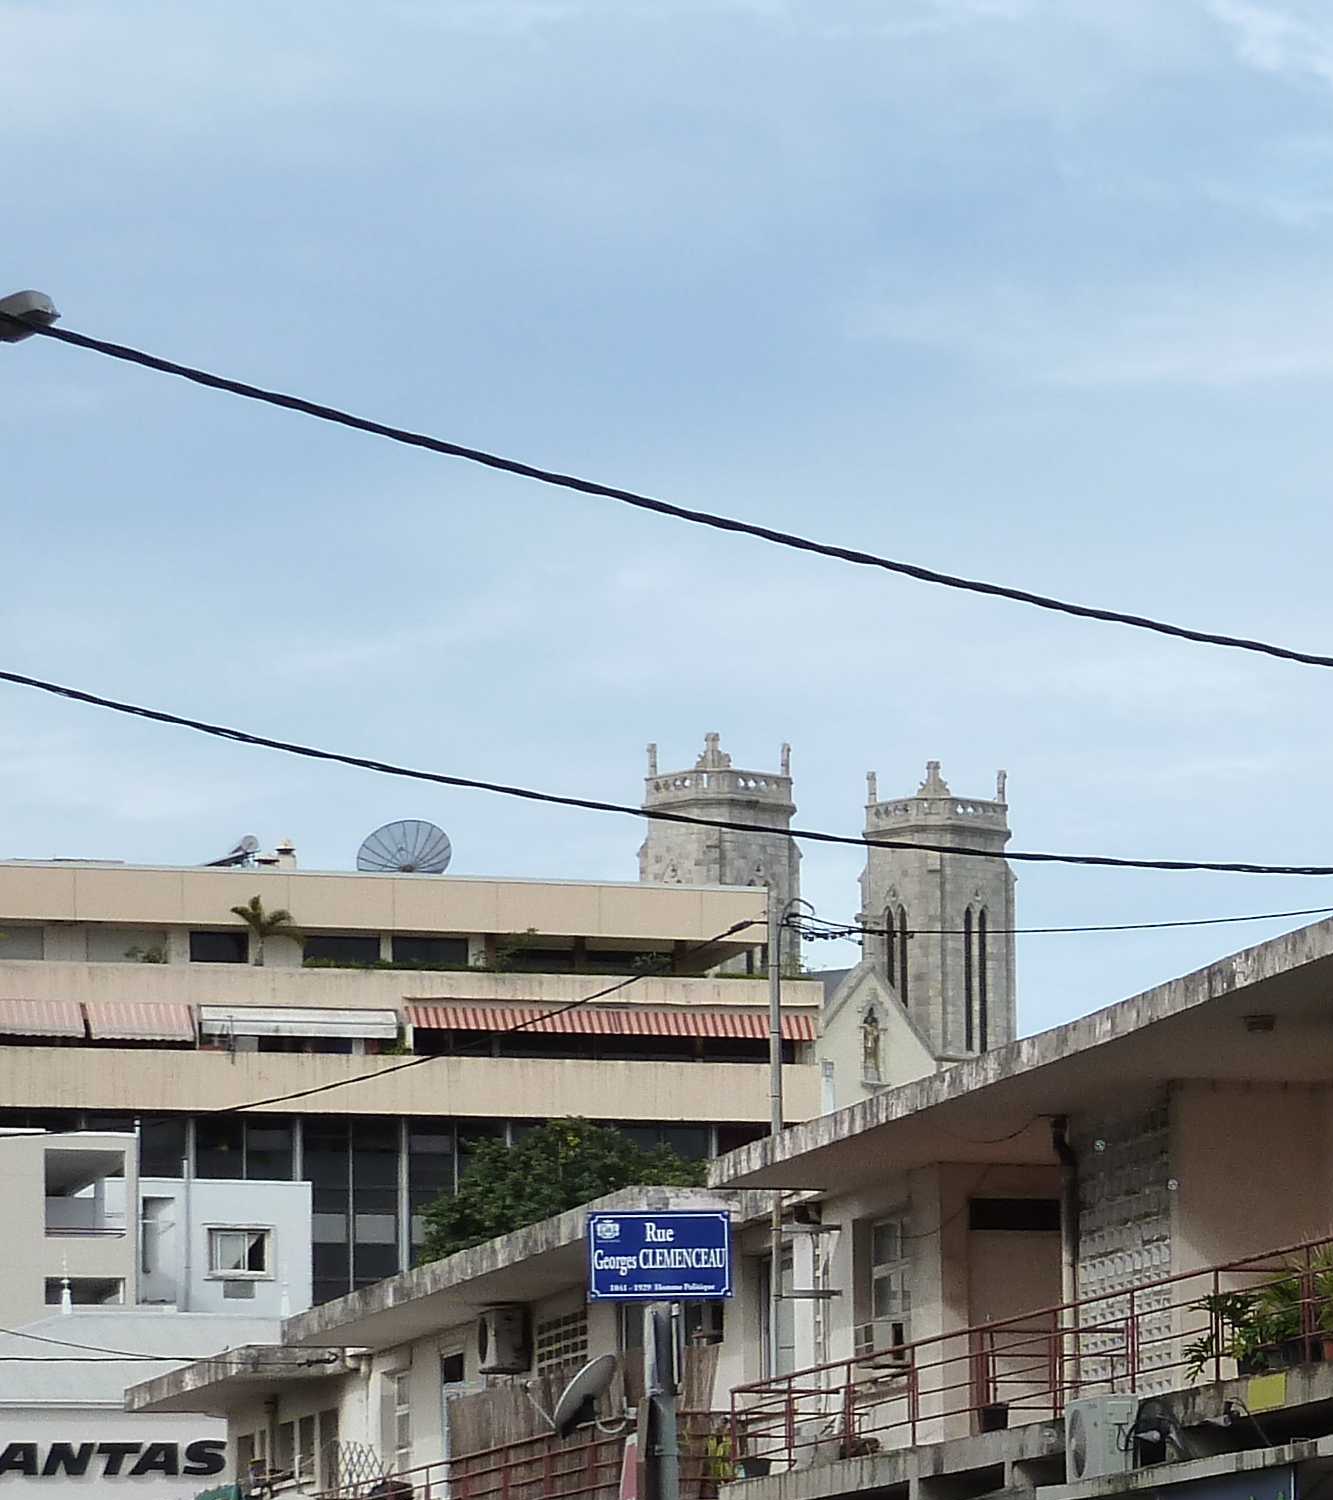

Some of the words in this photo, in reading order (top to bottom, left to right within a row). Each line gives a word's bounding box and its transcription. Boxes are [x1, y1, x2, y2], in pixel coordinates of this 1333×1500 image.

[644, 1222, 675, 1242] Rue
[594, 1249, 637, 1276] Georges
[638, 1247, 726, 1269] CLEMENCEAU
